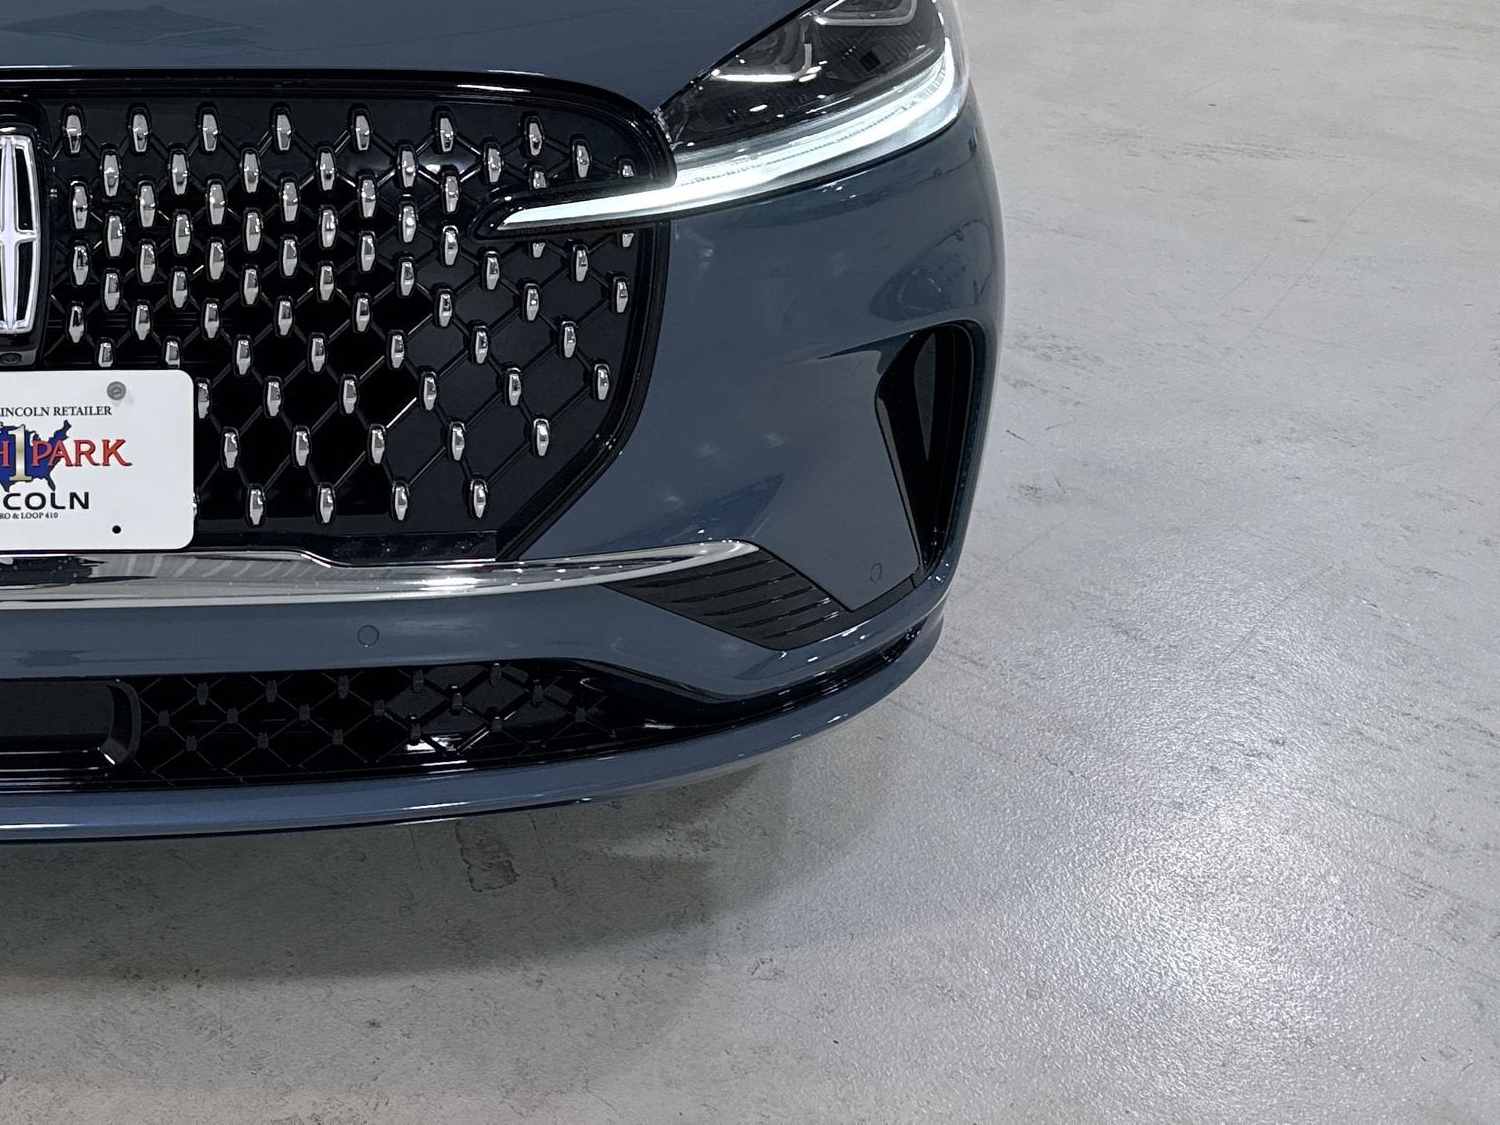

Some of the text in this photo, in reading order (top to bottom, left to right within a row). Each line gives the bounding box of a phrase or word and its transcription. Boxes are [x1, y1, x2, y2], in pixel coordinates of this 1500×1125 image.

[53, 405, 113, 417] RETAILER
[31, 438, 133, 467] PARK
[12, 512, 20, 520] &
[20, 512, 44, 520] LOOP
[45, 511, 59, 519] 410
